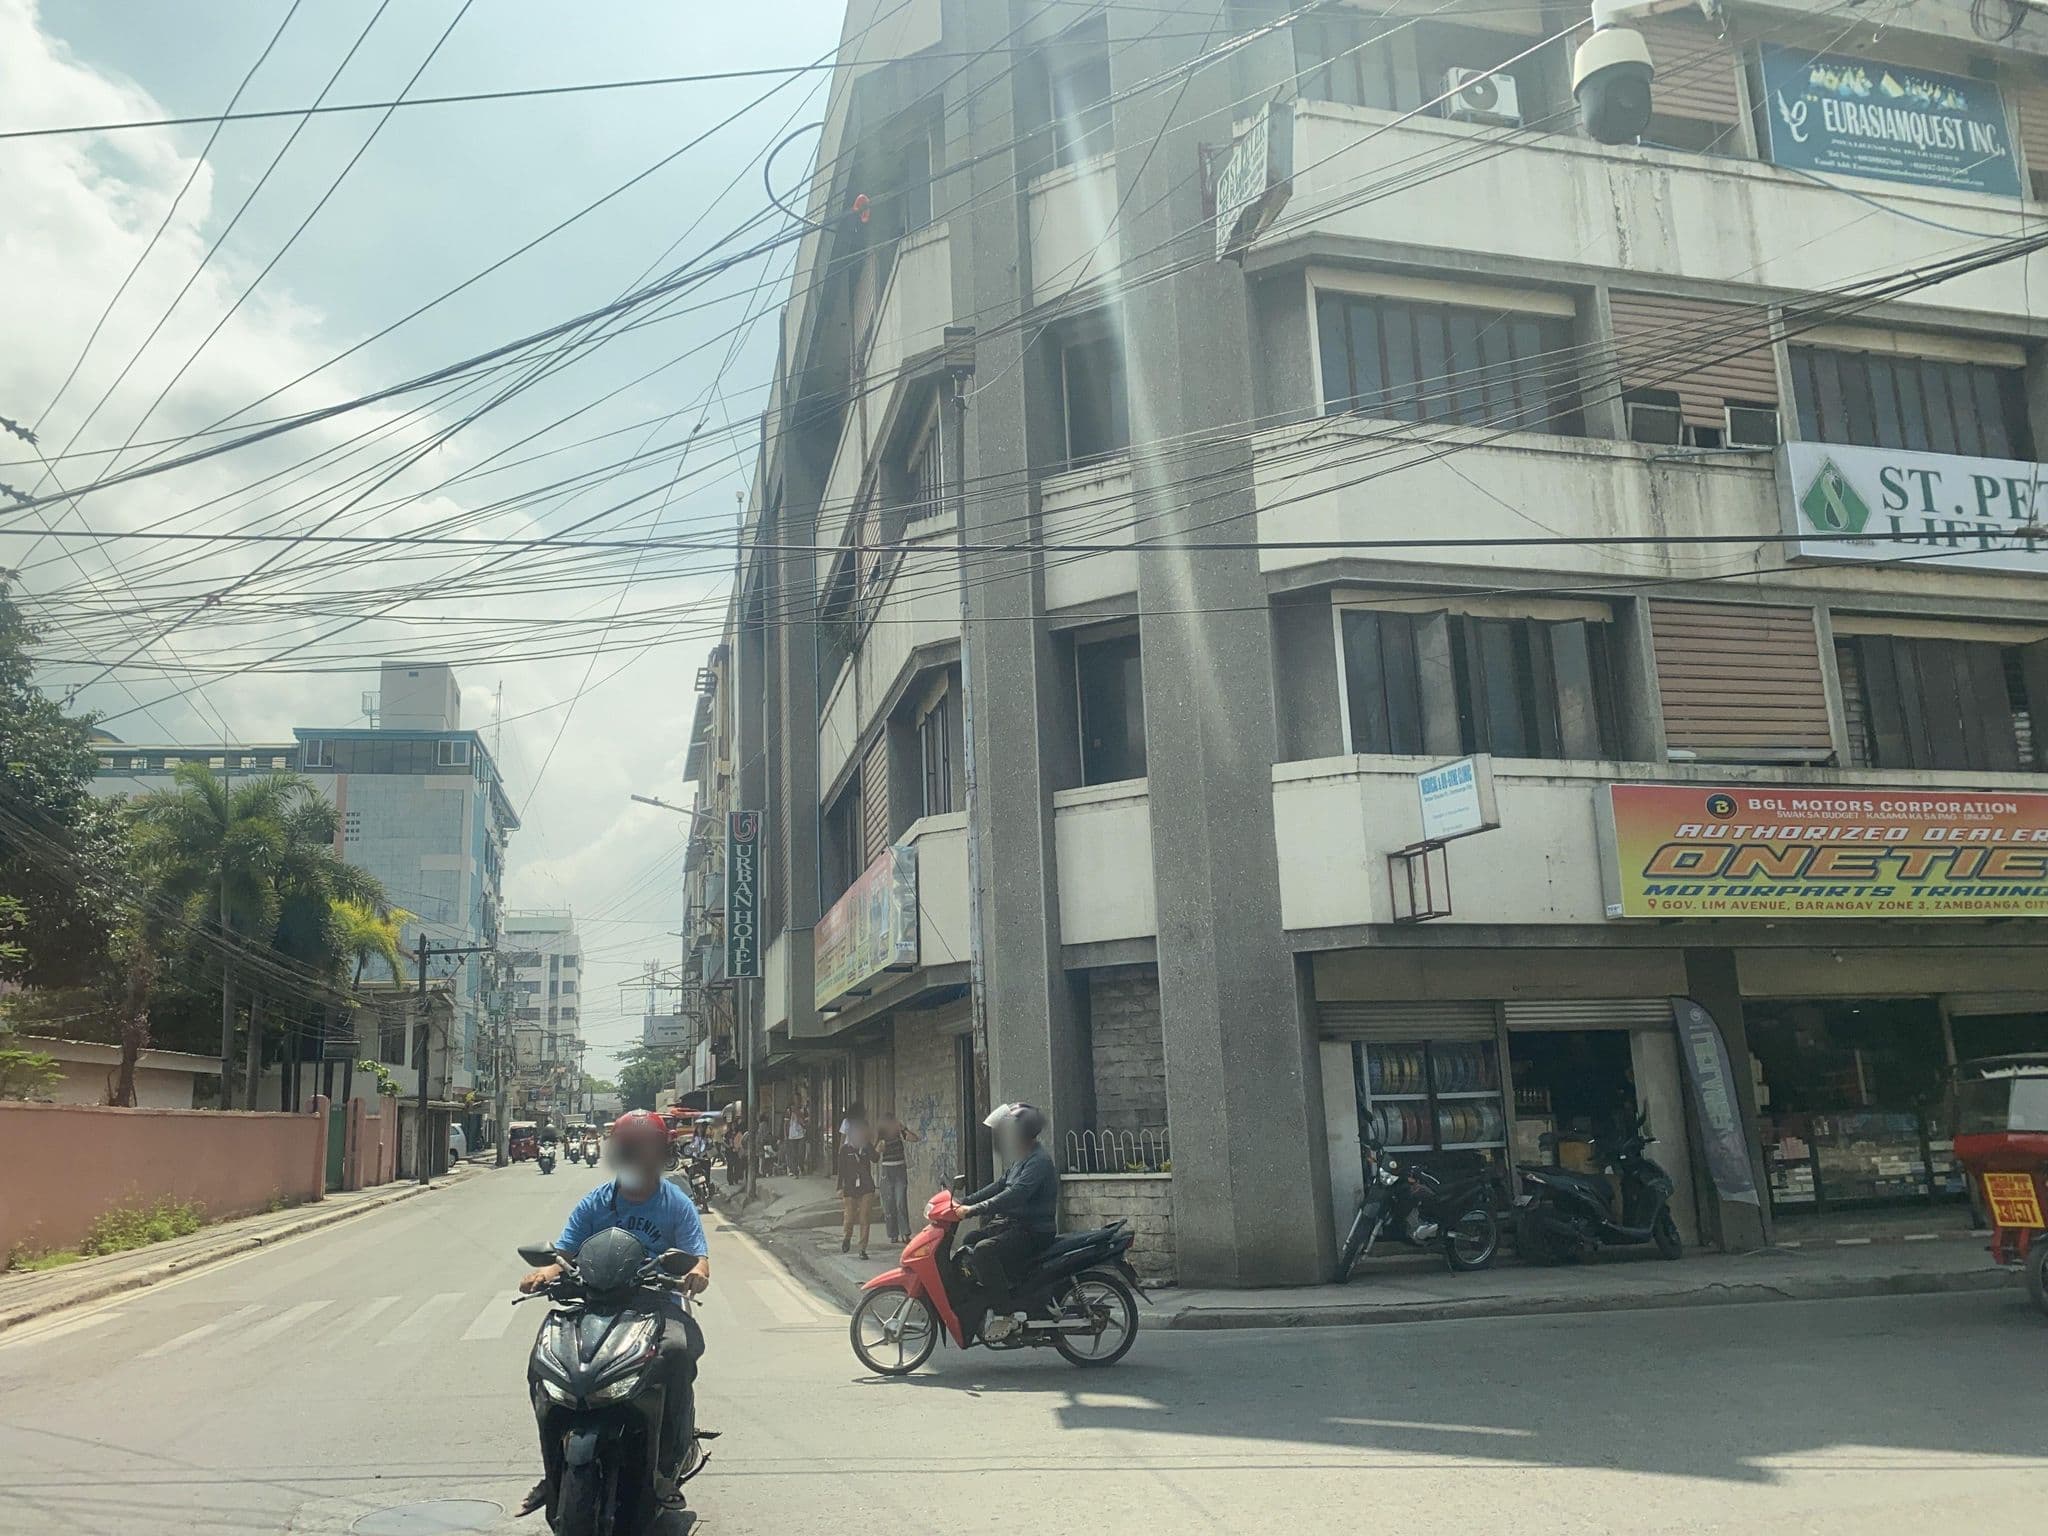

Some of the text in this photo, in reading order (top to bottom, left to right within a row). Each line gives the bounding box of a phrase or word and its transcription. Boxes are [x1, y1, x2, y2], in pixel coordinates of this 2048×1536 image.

[1968, 121, 2006, 156] INC.
[1748, 798, 2018, 813] BGL MOTORS CORPORATION
[1675, 824, 1910, 840] AUTHORIZED
[1643, 885, 1896, 897] MOTORPARTS
[732, 844, 753, 976] URBAN HOTEL
[1662, 900, 1697, 910] GOV.
[1701, 901, 1726, 910] LIM
[1730, 901, 1790, 911] AVENUE,
[1795, 901, 1873, 910] BARANGAY
[1878, 901, 1914, 910] ZONE
[1935, 900, 2020, 910] ZAMBOANGA
[627, 1216, 662, 1243] DENIM
